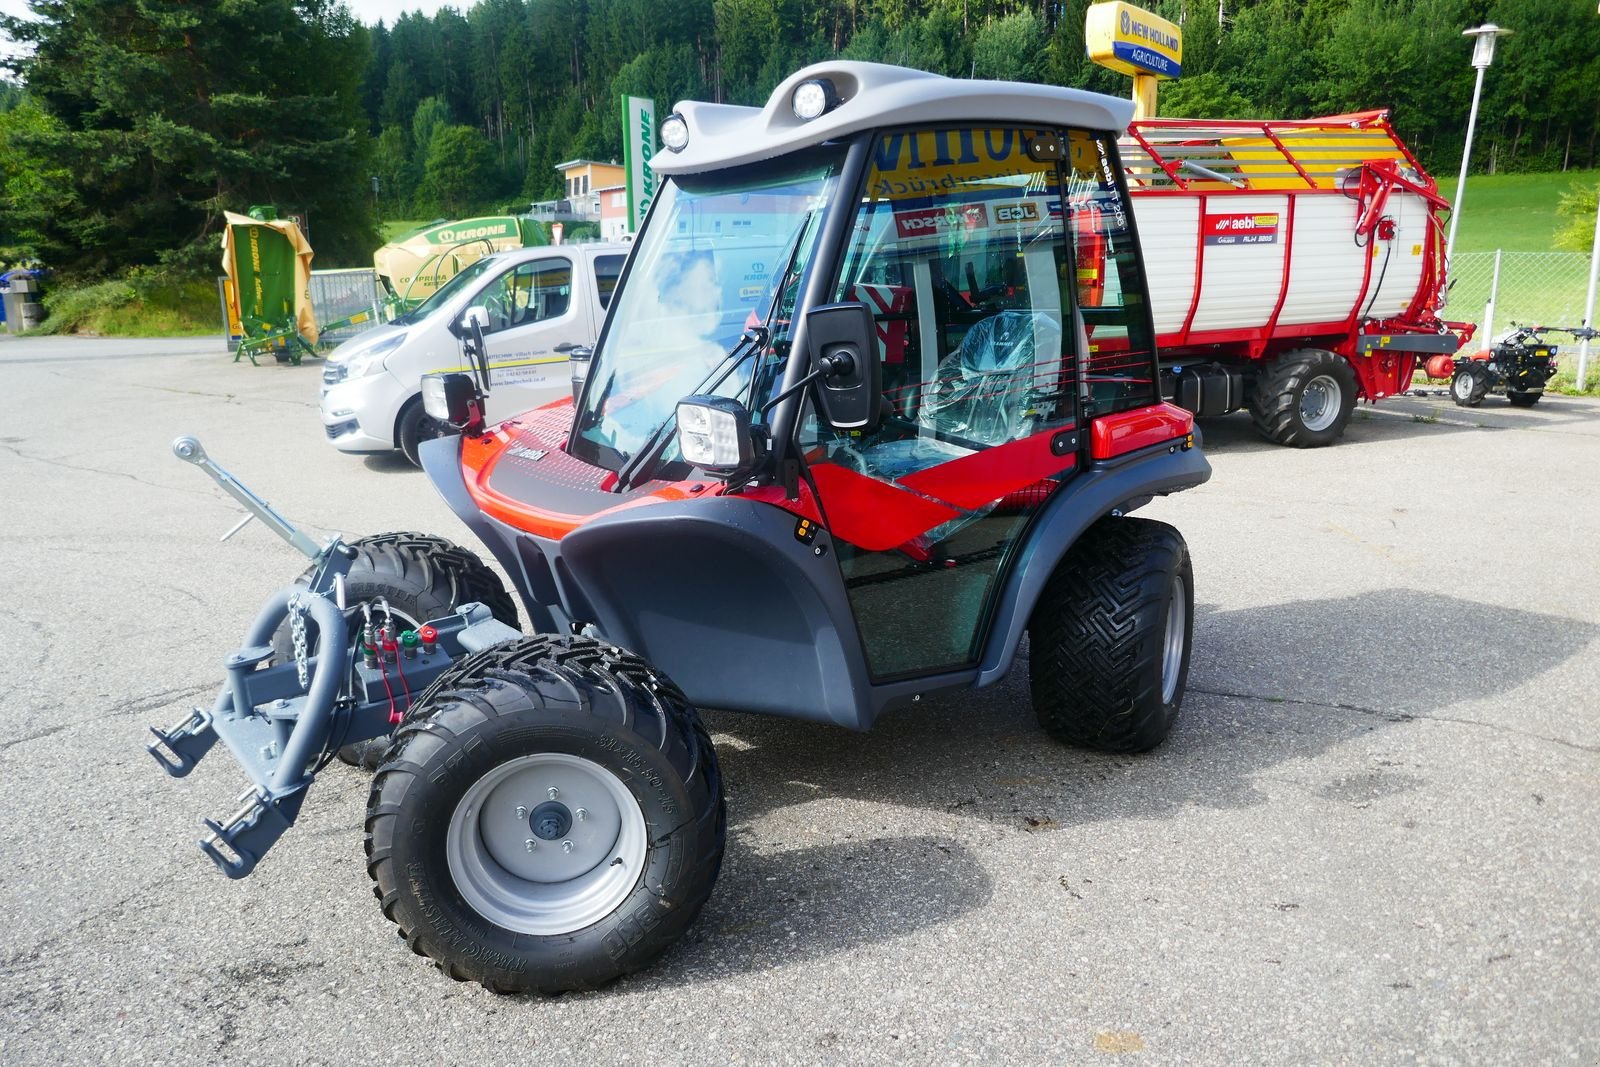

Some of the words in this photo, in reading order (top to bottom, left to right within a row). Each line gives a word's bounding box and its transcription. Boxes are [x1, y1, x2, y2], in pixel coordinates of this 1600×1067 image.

[1131, 20, 1149, 40] NEW
[1149, 27, 1178, 52] HOLLAND
[1131, 48, 1168, 72] AGRICULTURE
[640, 107, 653, 198] KRONE
[1101, 158, 1114, 187] aebi
[455, 224, 507, 241] KRONE
[1231, 216, 1256, 230] aebi
